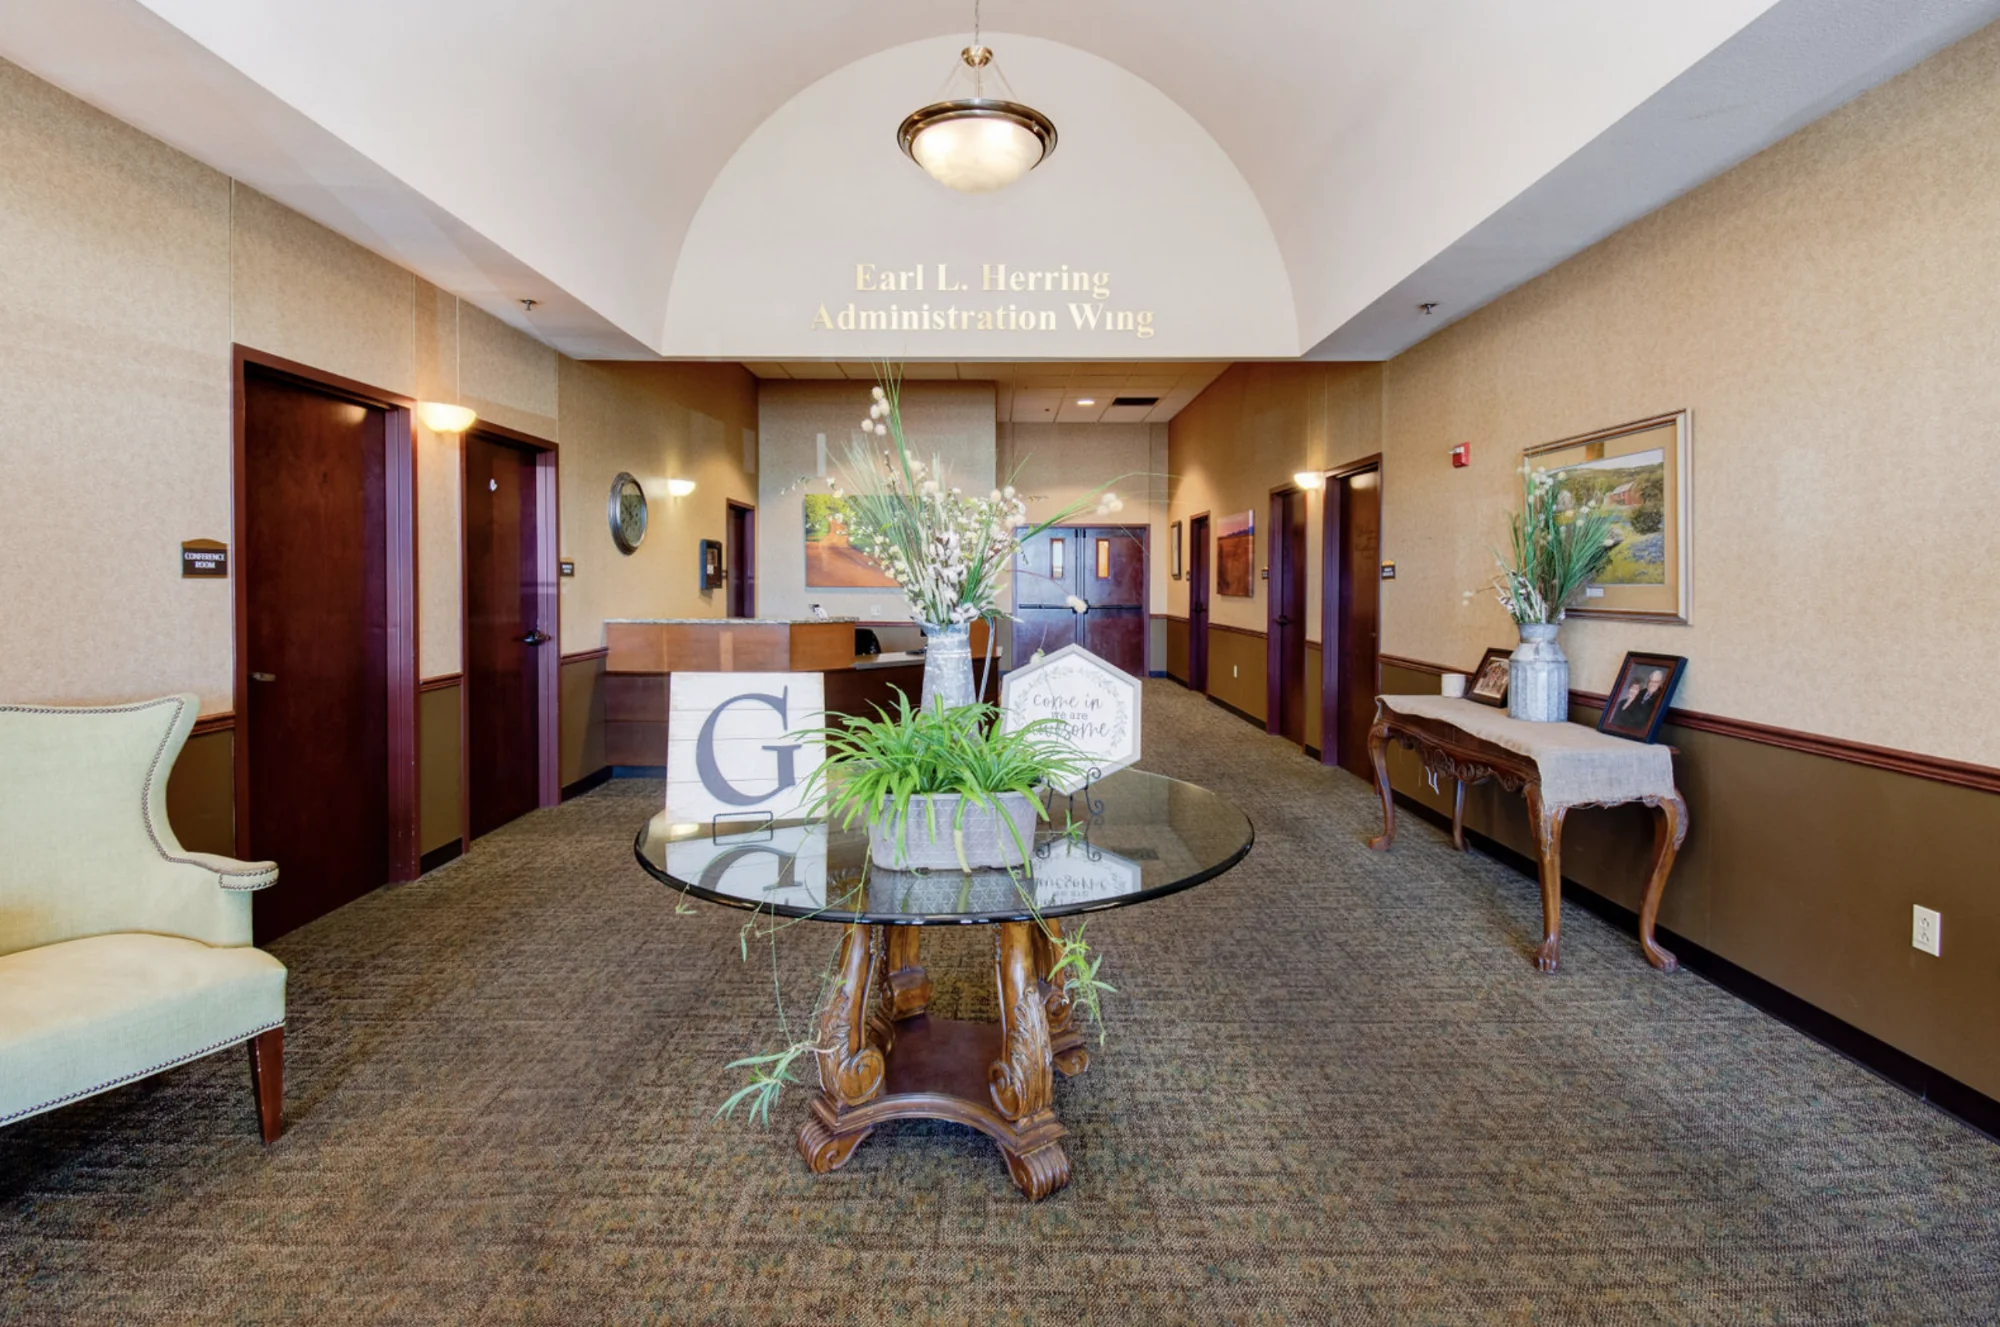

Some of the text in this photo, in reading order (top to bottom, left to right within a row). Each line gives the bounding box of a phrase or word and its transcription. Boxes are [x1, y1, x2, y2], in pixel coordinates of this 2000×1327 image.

[854, 263, 1111, 299] Earl L. Herring
[810, 302, 1156, 339] Administration Wing
[195, 561, 215, 569] ROOM
[1085, 693, 1103, 710] in
[1069, 711, 1089, 720] are
[696, 685, 803, 806] G
